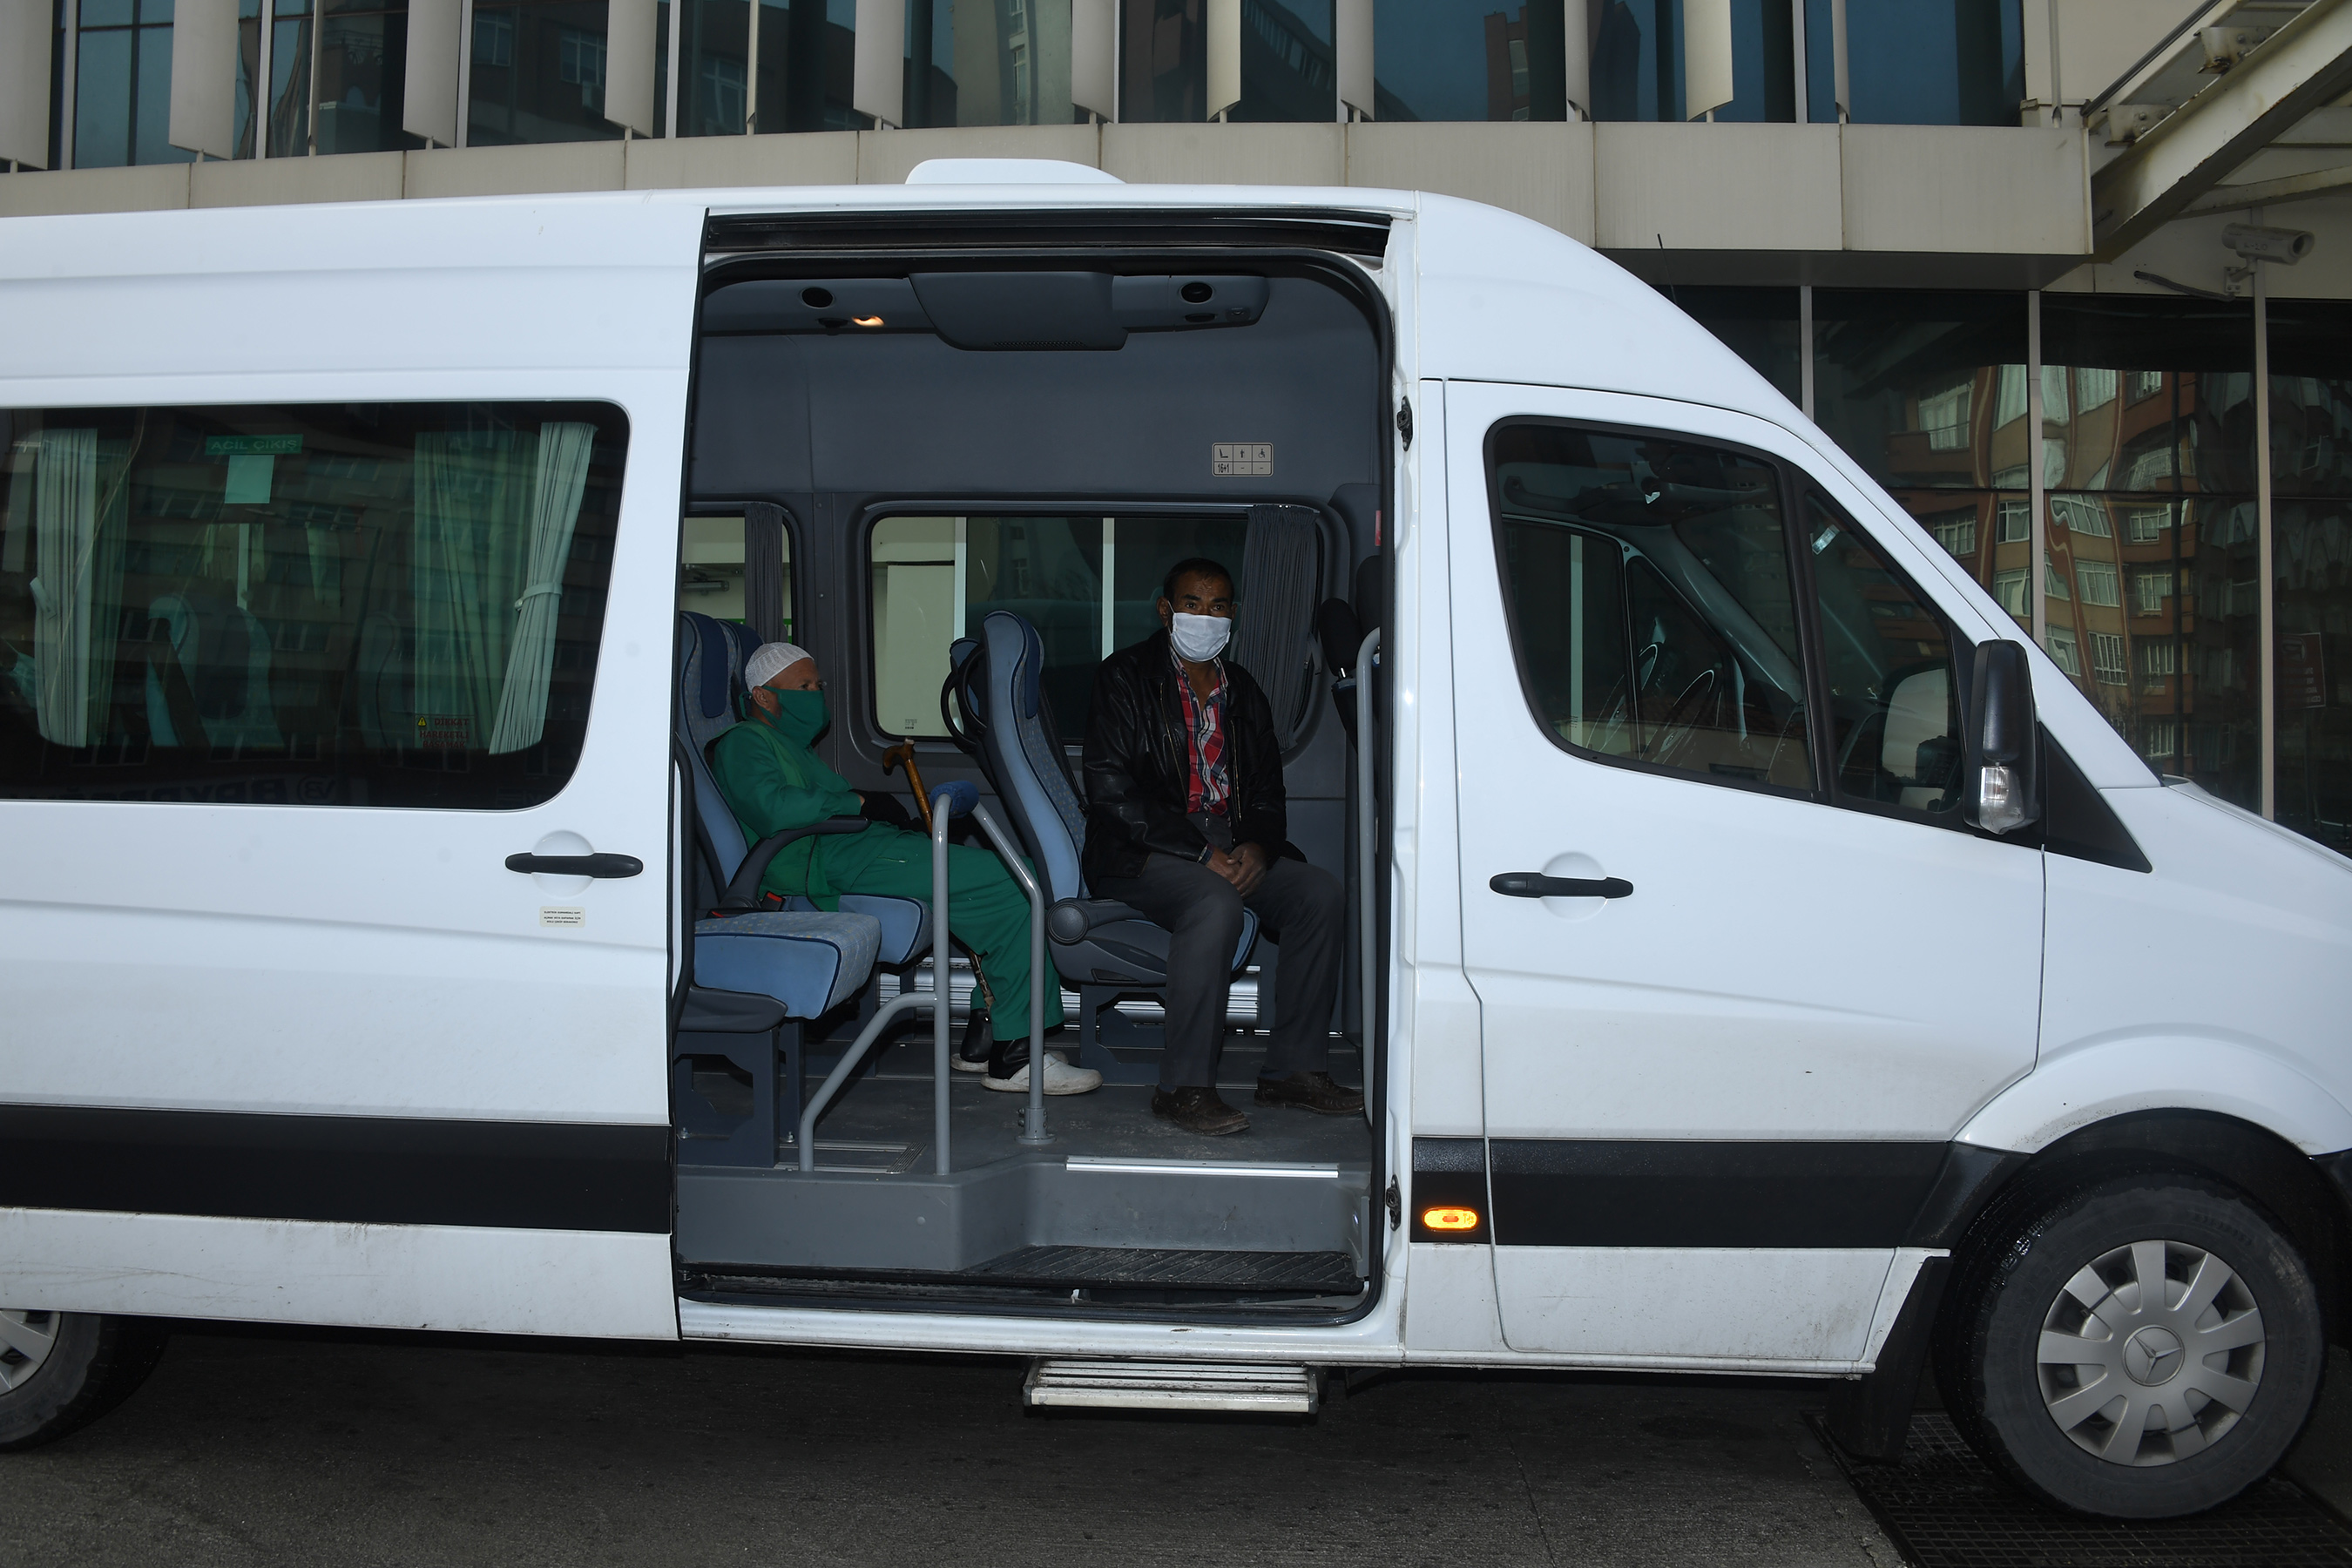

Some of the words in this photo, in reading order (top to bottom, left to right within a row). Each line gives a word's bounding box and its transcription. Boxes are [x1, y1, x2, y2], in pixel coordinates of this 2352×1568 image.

[212, 440, 248, 449] ACİL
[253, 440, 297, 450] ÇIKIŞ
[1218, 463, 1229, 473] 16+1
[435, 716, 469, 726] DİKKAT
[420, 730, 469, 739] HAREKETLİ
